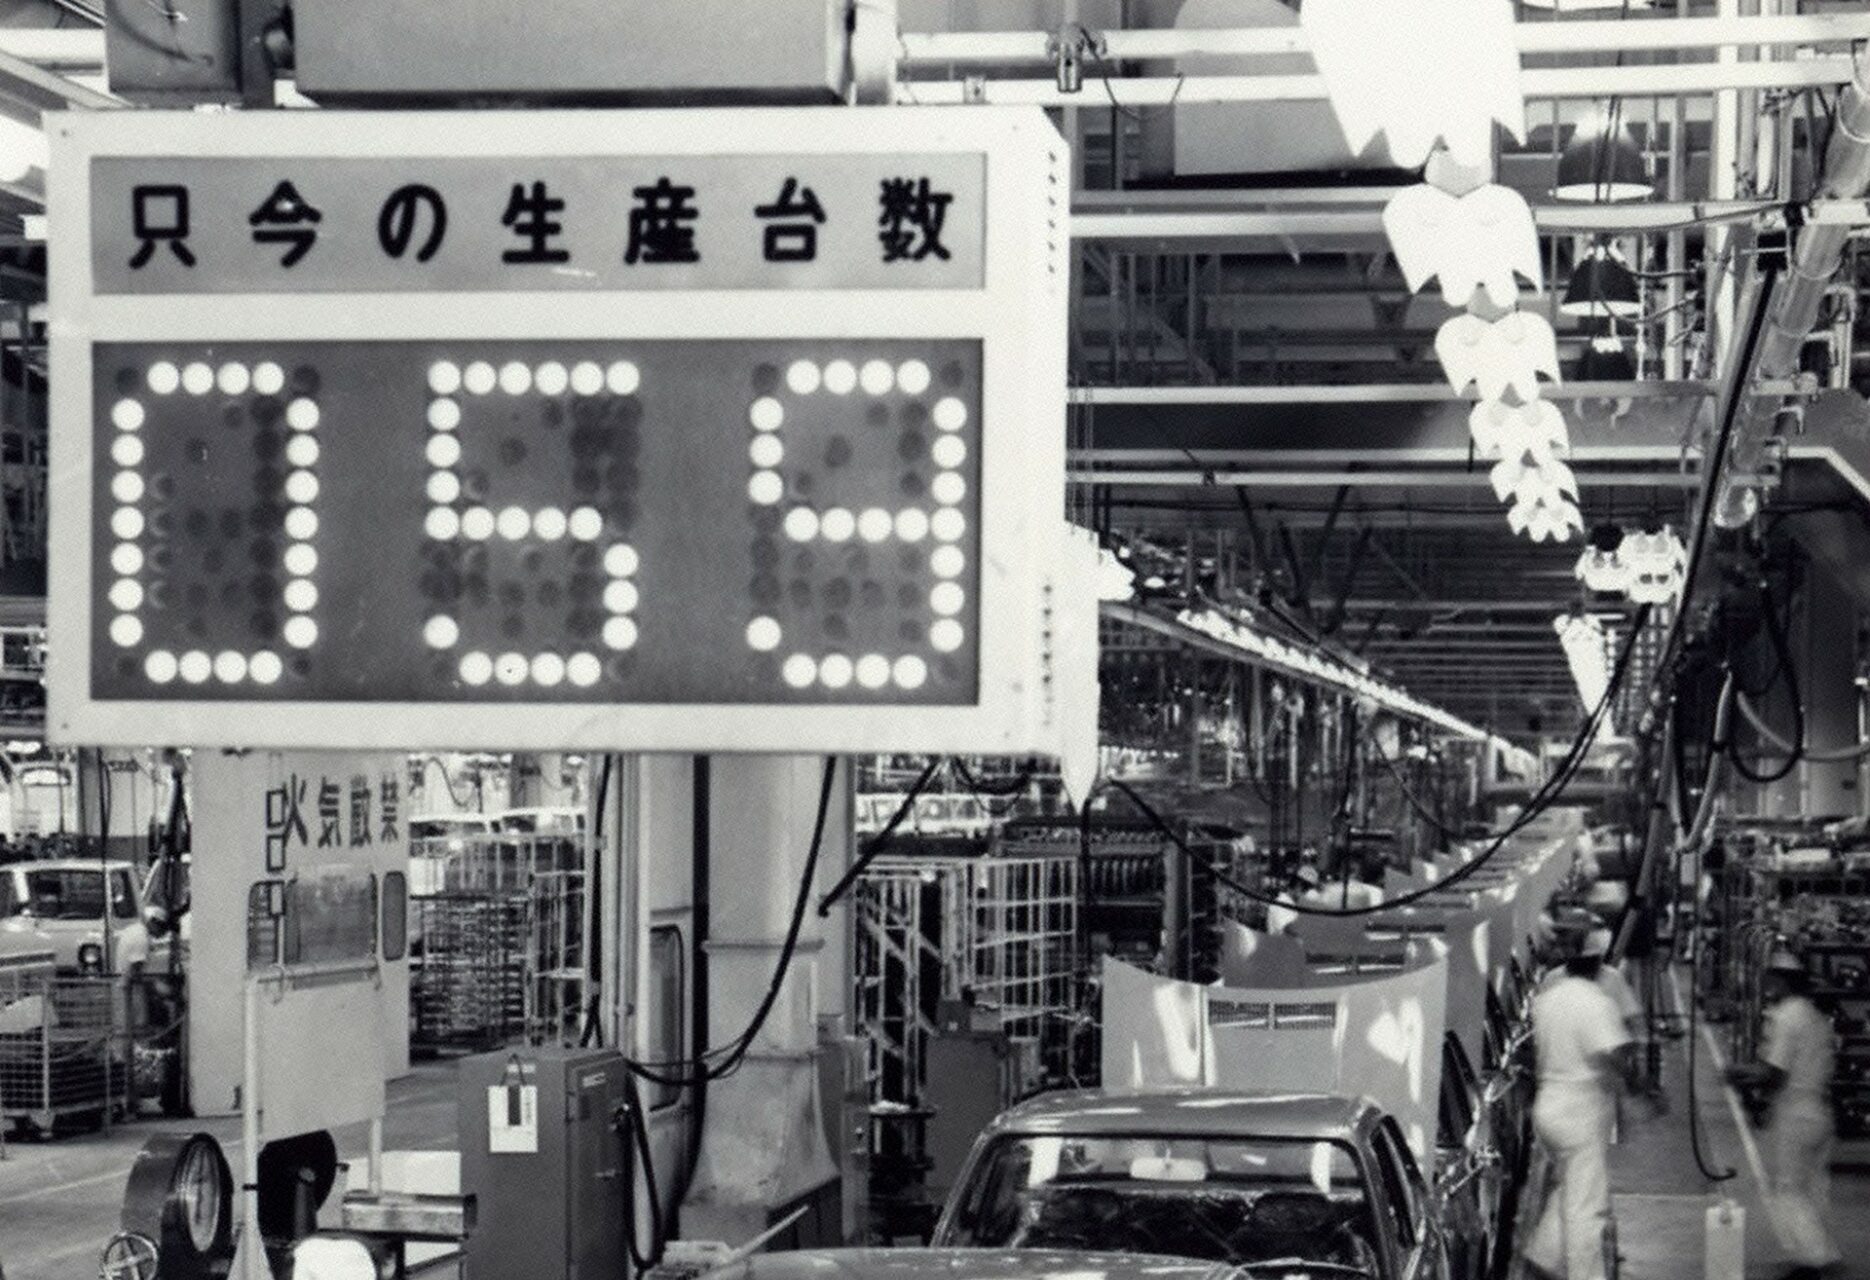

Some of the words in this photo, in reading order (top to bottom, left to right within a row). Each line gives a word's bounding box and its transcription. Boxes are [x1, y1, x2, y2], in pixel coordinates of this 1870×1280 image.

[130, 179, 953, 270] 只今の生産台数
